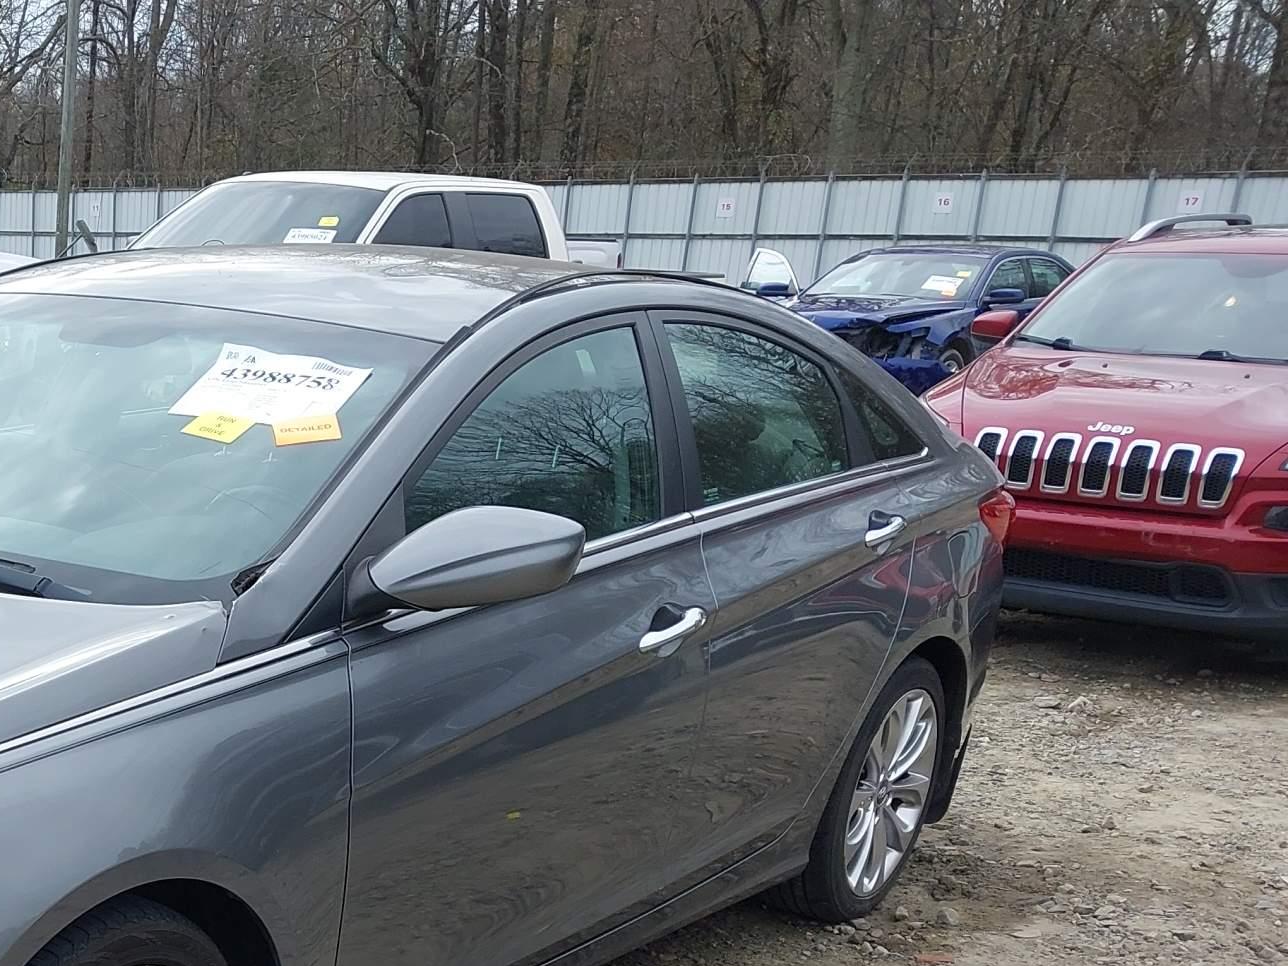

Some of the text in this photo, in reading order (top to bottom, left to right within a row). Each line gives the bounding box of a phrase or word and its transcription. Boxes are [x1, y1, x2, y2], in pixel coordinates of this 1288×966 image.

[938, 198, 950, 206] 16
[1185, 196, 1199, 206] 17
[722, 203, 732, 211] 15
[220, 367, 341, 391] 43988758
[279, 423, 333, 433] DETAILED
[1087, 421, 1135, 436] Jeep
